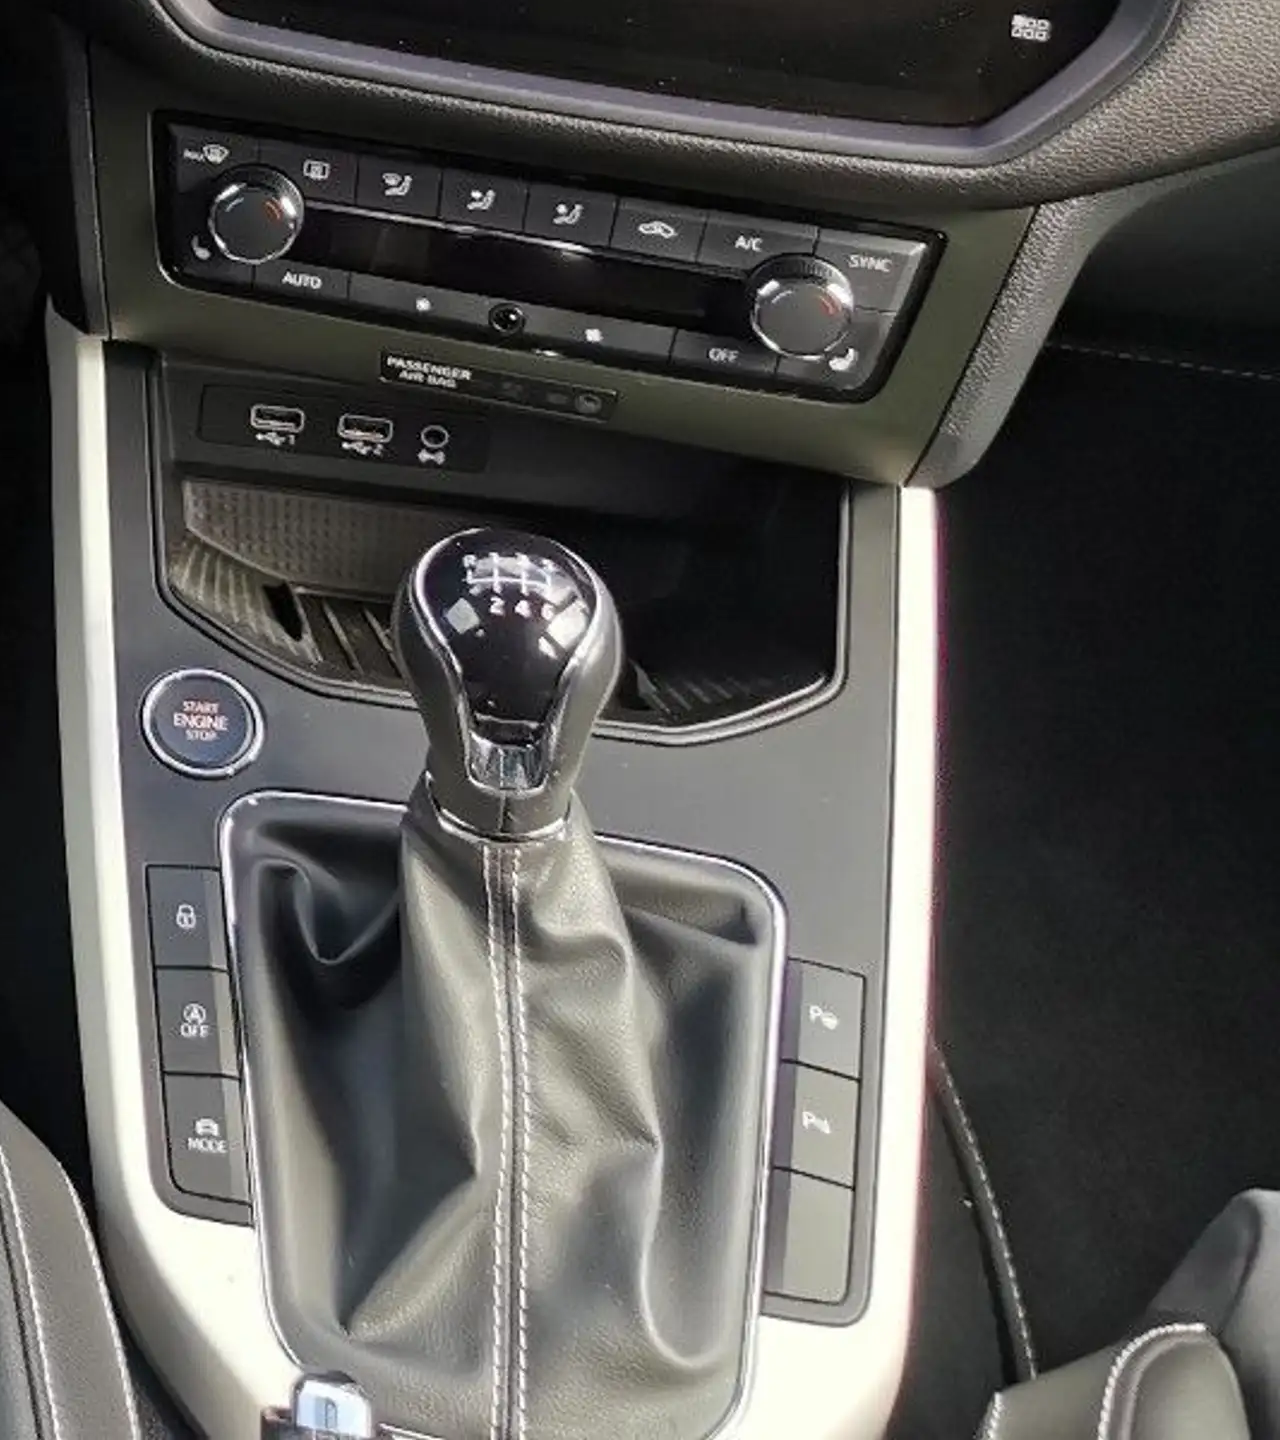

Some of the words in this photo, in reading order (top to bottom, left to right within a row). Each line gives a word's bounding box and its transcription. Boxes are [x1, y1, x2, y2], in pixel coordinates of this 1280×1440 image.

[735, 236, 763, 252] A/C
[848, 255, 891, 273] SYNC
[282, 271, 322, 289] AUTO
[708, 347, 739, 362] OFF
[386, 355, 473, 381] PASSENGER
[182, 700, 219, 714] START
[173, 712, 229, 732] ENGINE
[185, 729, 218, 741] STOP
[180, 1024, 209, 1038] OFF
[188, 1136, 227, 1154] MODE
